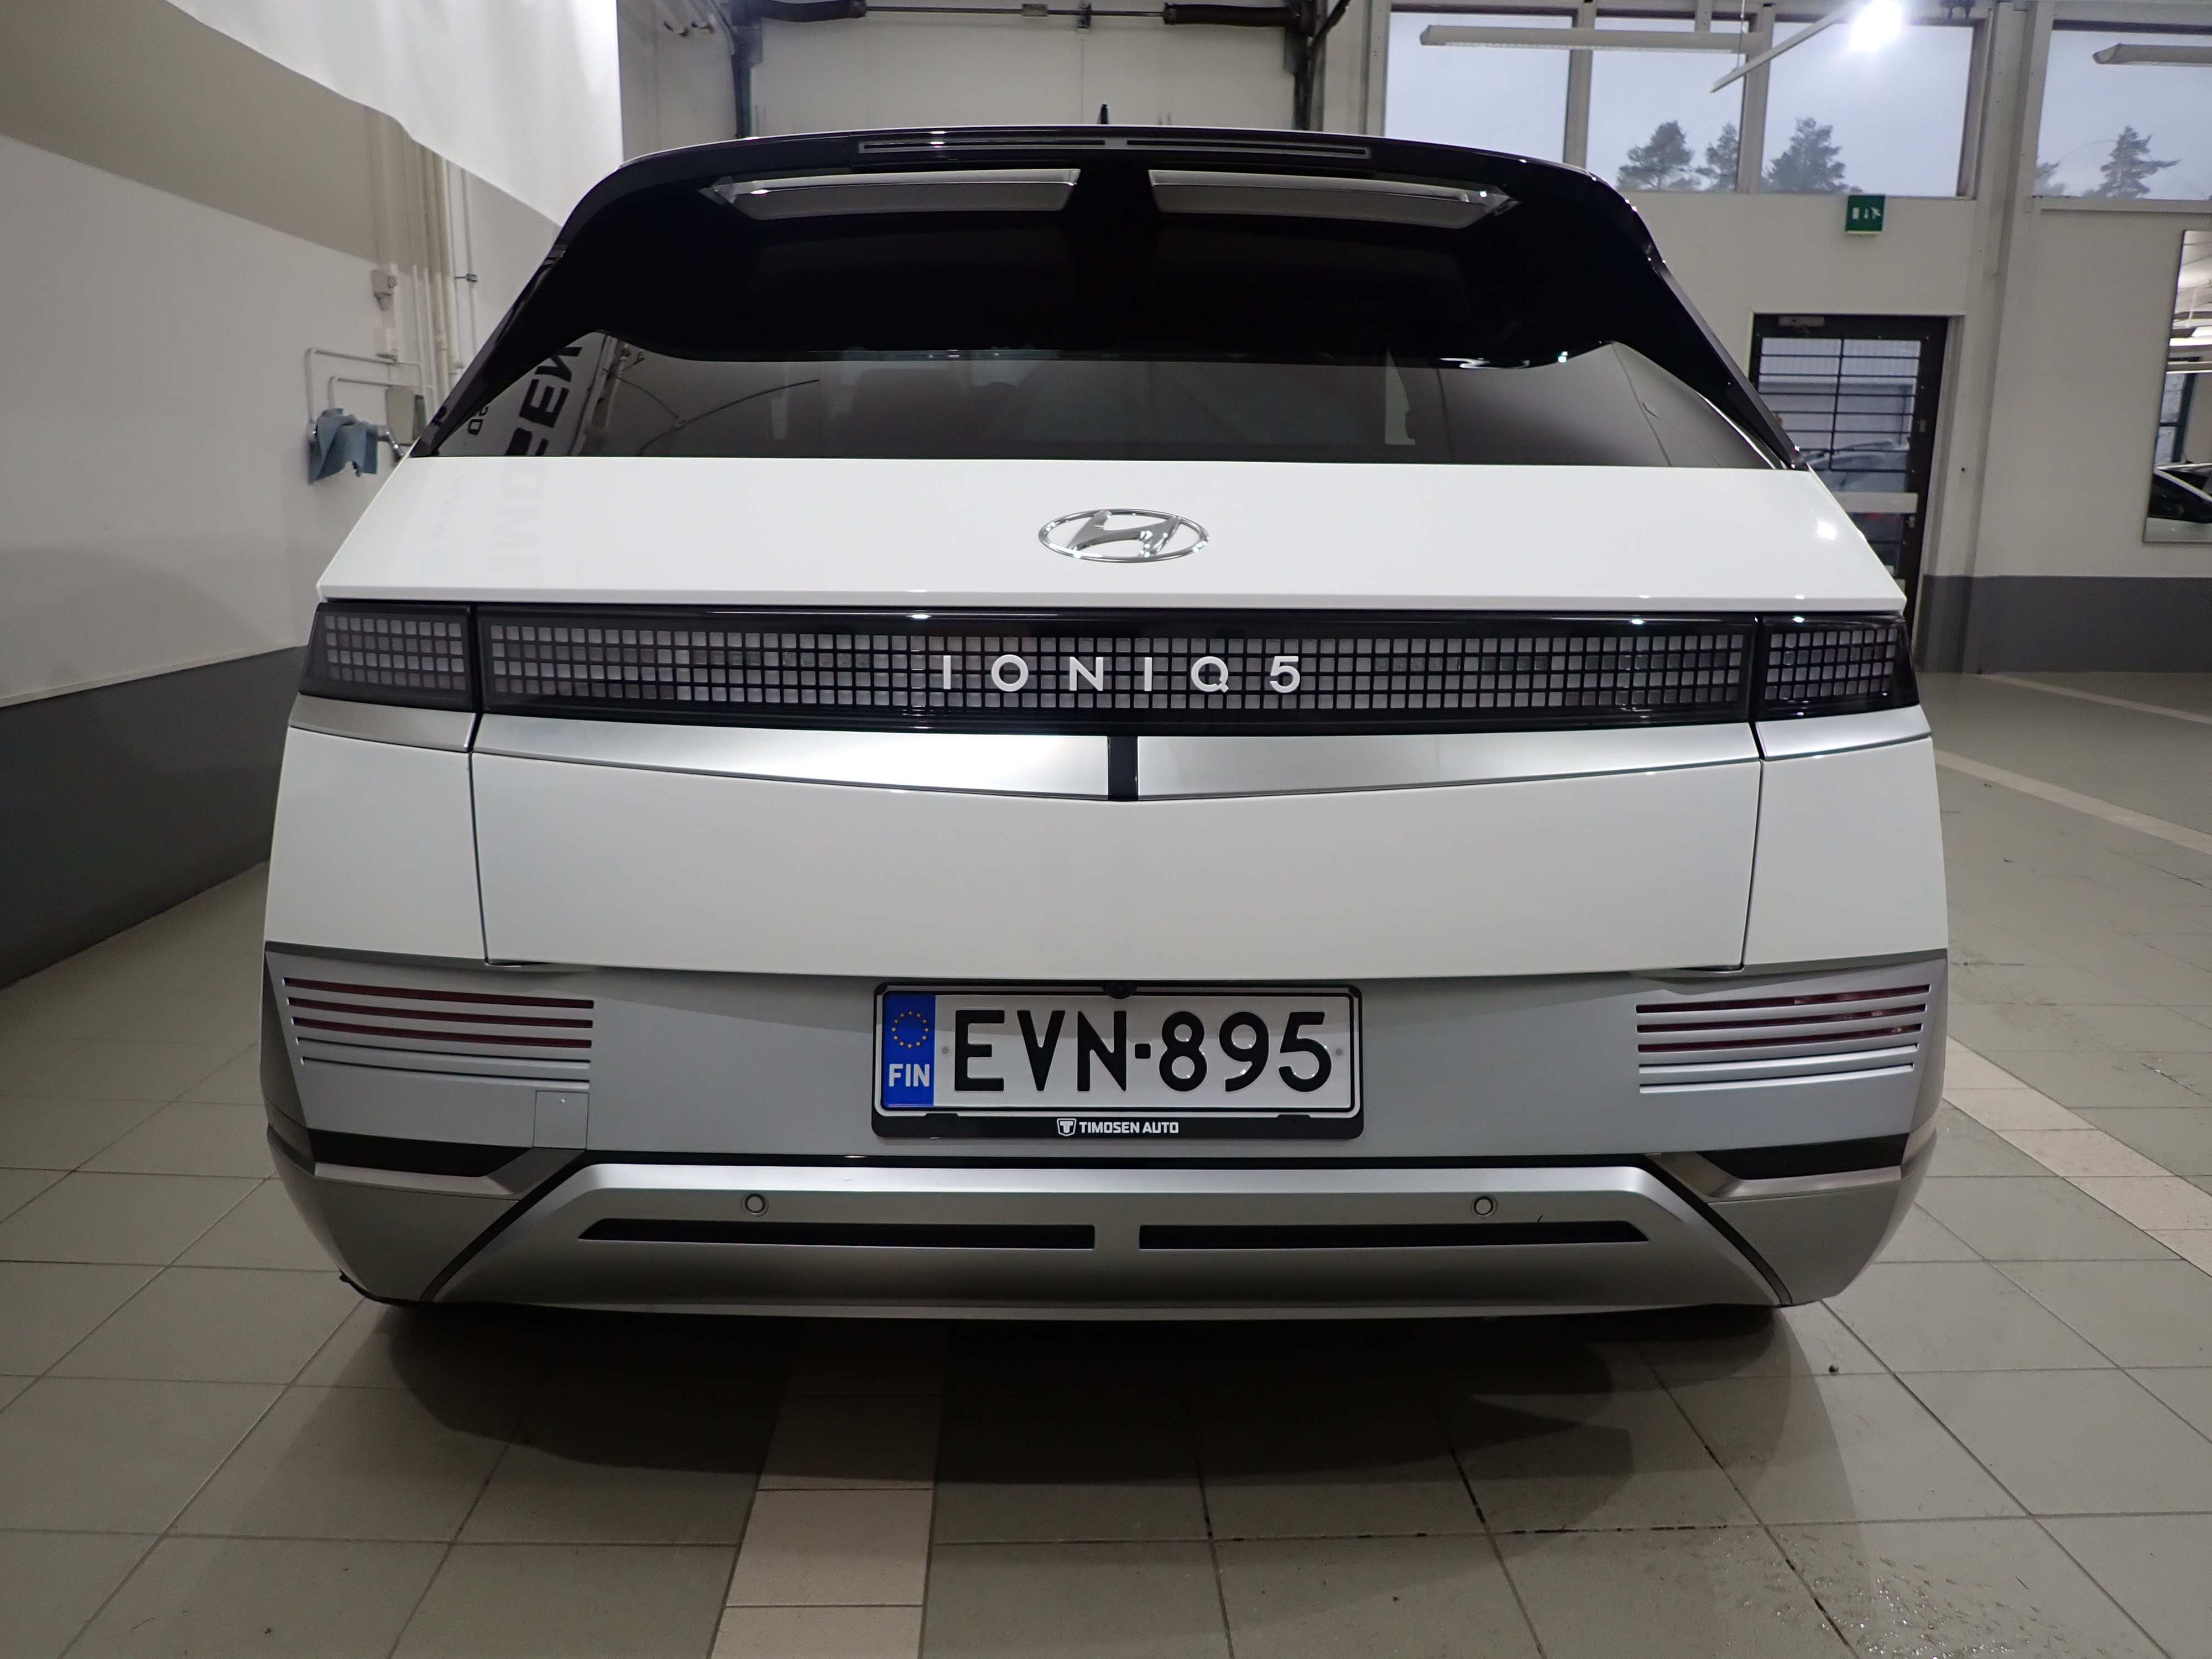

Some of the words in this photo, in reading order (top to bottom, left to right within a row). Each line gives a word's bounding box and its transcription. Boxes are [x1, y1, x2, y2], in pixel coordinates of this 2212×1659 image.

[942, 654, 1229, 693] IONIQ
[1269, 655, 1301, 693] 5
[888, 1063, 931, 1088] FIN
[1078, 1121, 1140, 1134] TIMOSEN
[1141, 1121, 1180, 1134] AUTO
